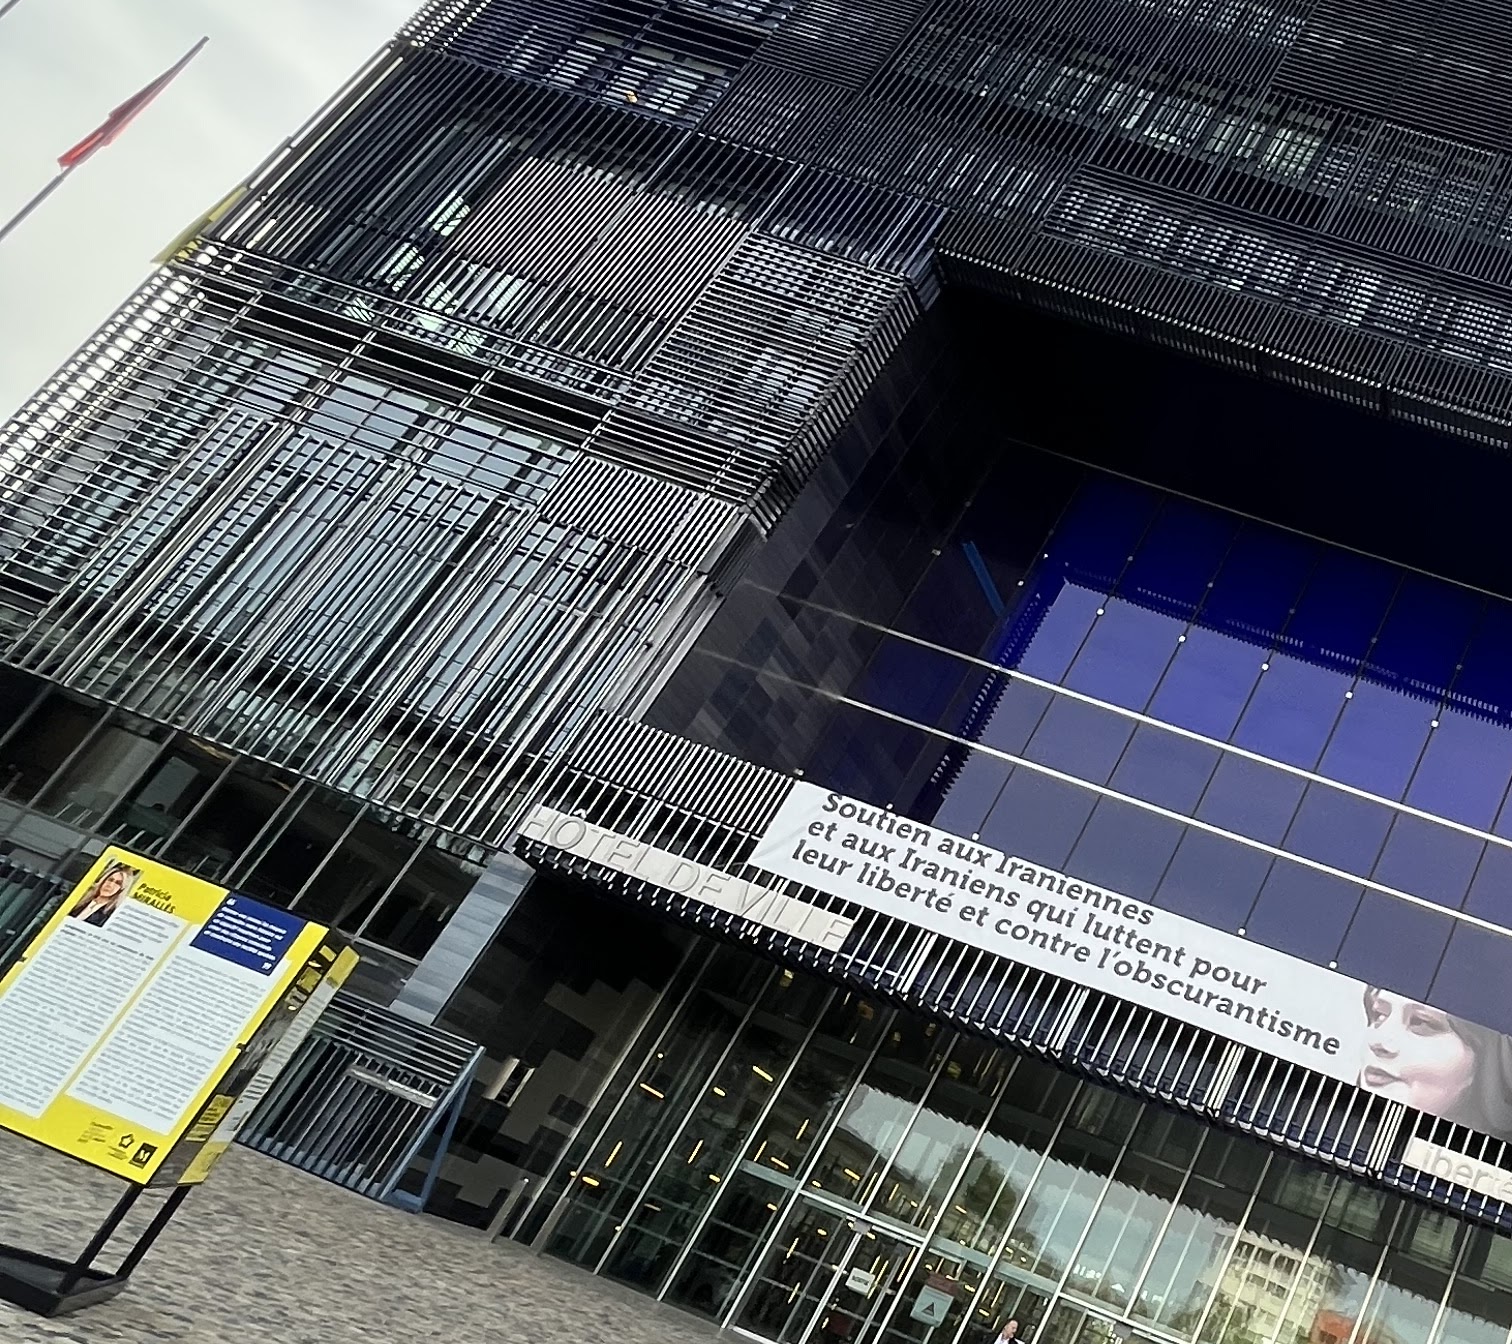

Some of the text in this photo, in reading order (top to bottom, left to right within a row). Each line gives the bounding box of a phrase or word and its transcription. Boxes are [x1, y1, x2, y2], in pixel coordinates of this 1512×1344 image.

[520, 808, 854, 947] HÔTEL DE VILLE
[808, 819, 1269, 996] et aux Iraniens qui luttent pour
[821, 792, 1155, 926] Soutien aux Iraniennes
[791, 839, 1342, 1056] leur liberté et contre l'obscurantisme
